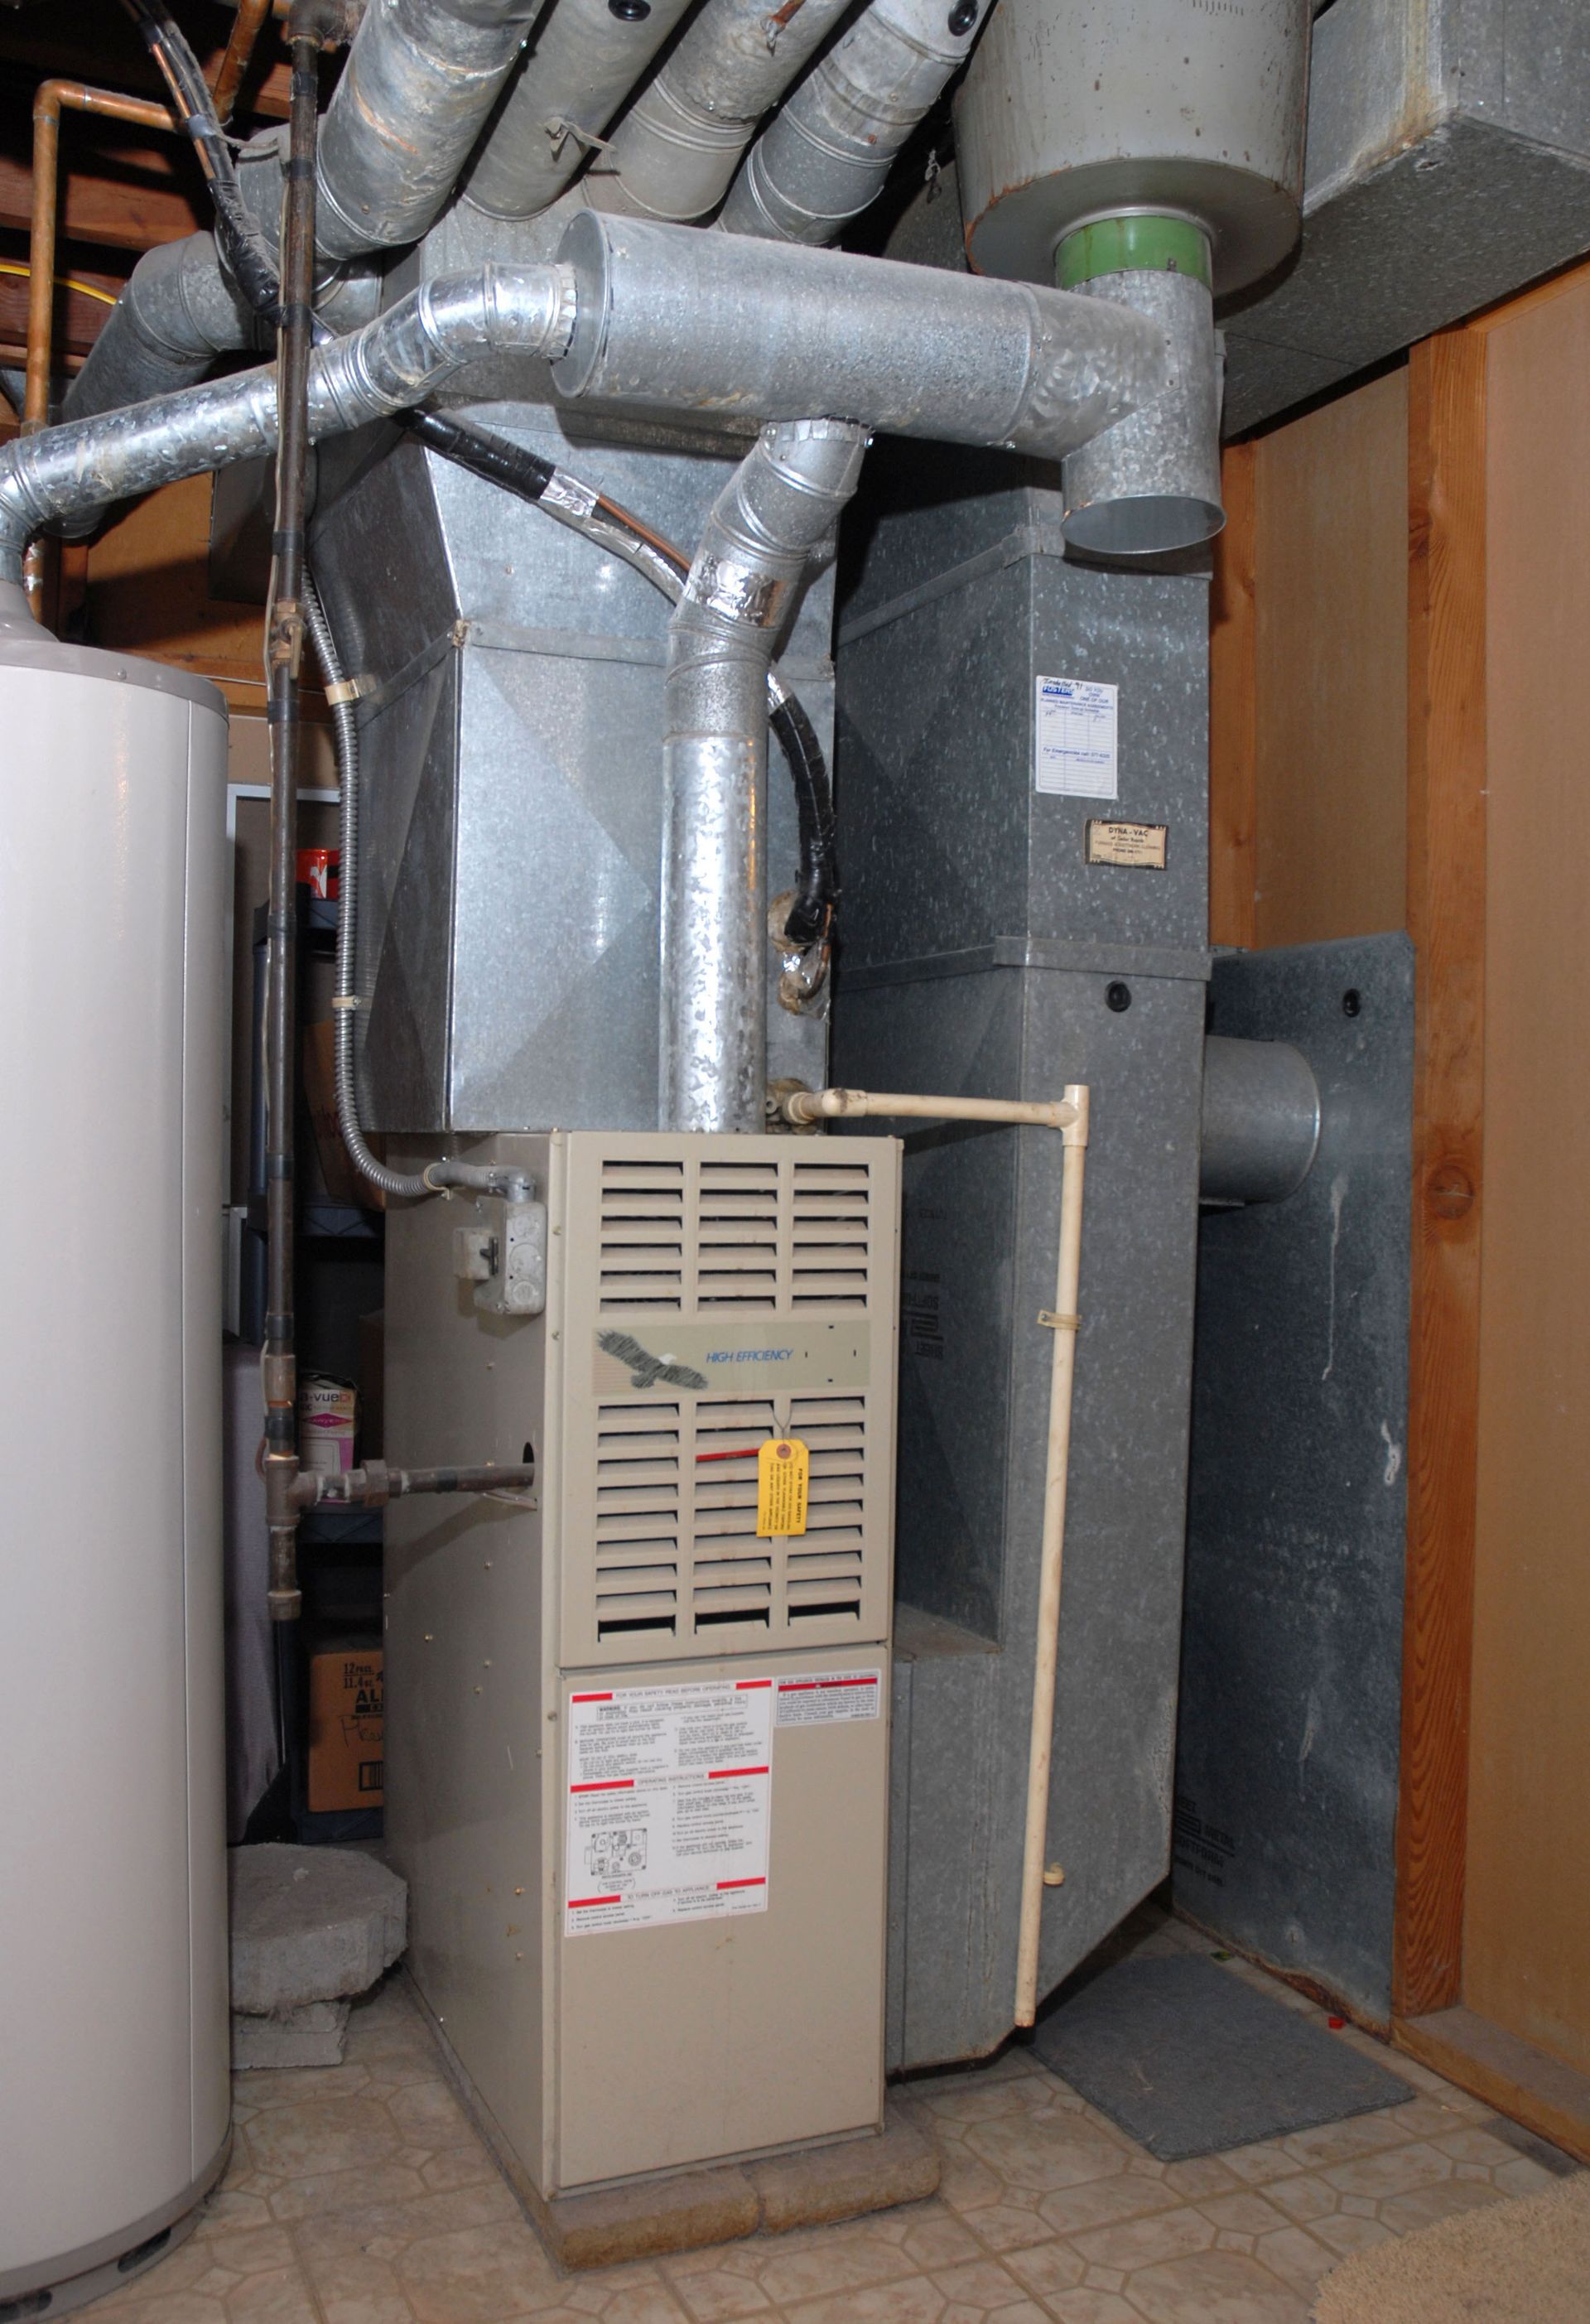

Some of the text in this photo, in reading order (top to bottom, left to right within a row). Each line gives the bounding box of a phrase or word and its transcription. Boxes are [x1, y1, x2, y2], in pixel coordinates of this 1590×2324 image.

[706, 1348, 794, 1363] HIGH EFFICIENCY
[344, 1663, 354, 1674] 12
[668, 1772, 704, 1781] INSTRUCTIONS
